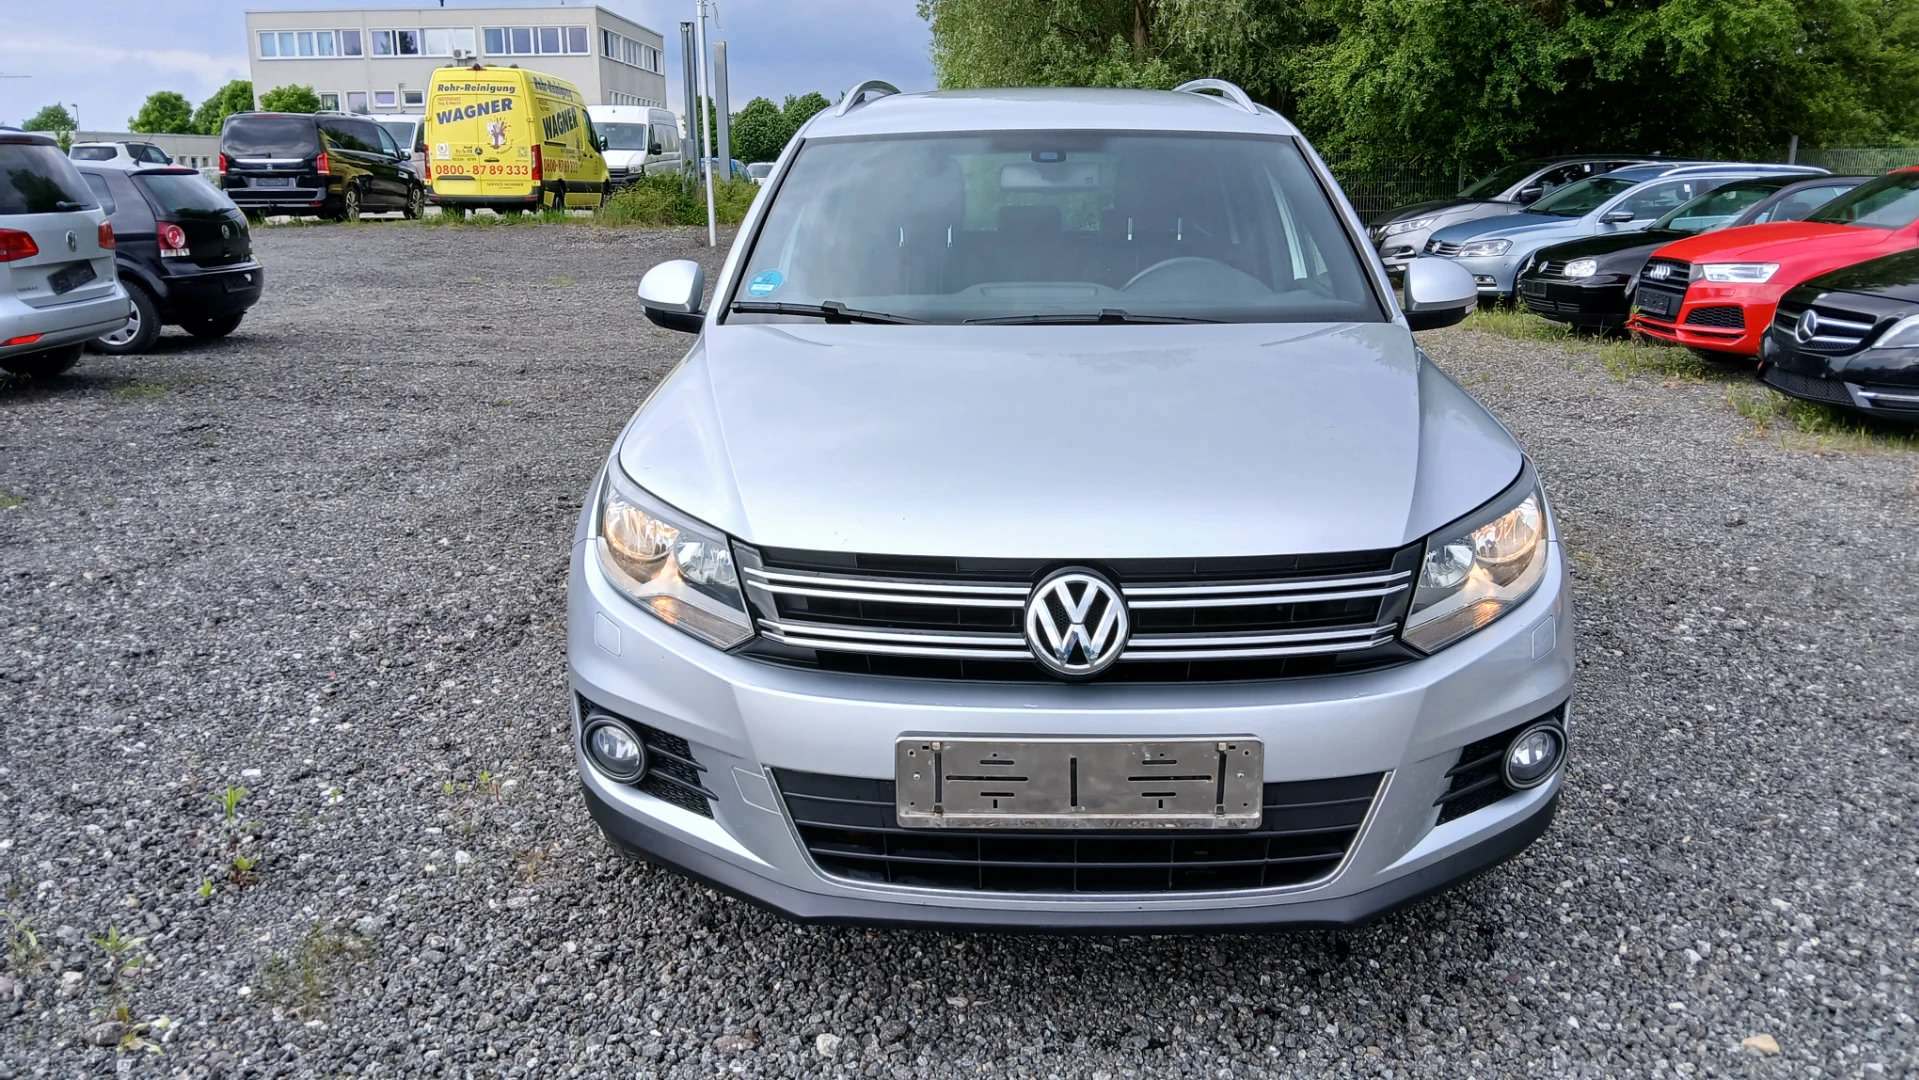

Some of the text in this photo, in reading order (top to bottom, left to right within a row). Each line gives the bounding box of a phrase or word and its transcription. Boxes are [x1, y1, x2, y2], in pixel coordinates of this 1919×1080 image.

[437, 83, 516, 94] Rohr-Reinigung
[436, 97, 513, 125] WAGNER
[542, 106, 579, 141] WAGNER
[435, 164, 464, 175] 0800
[506, 164, 529, 176] 333
